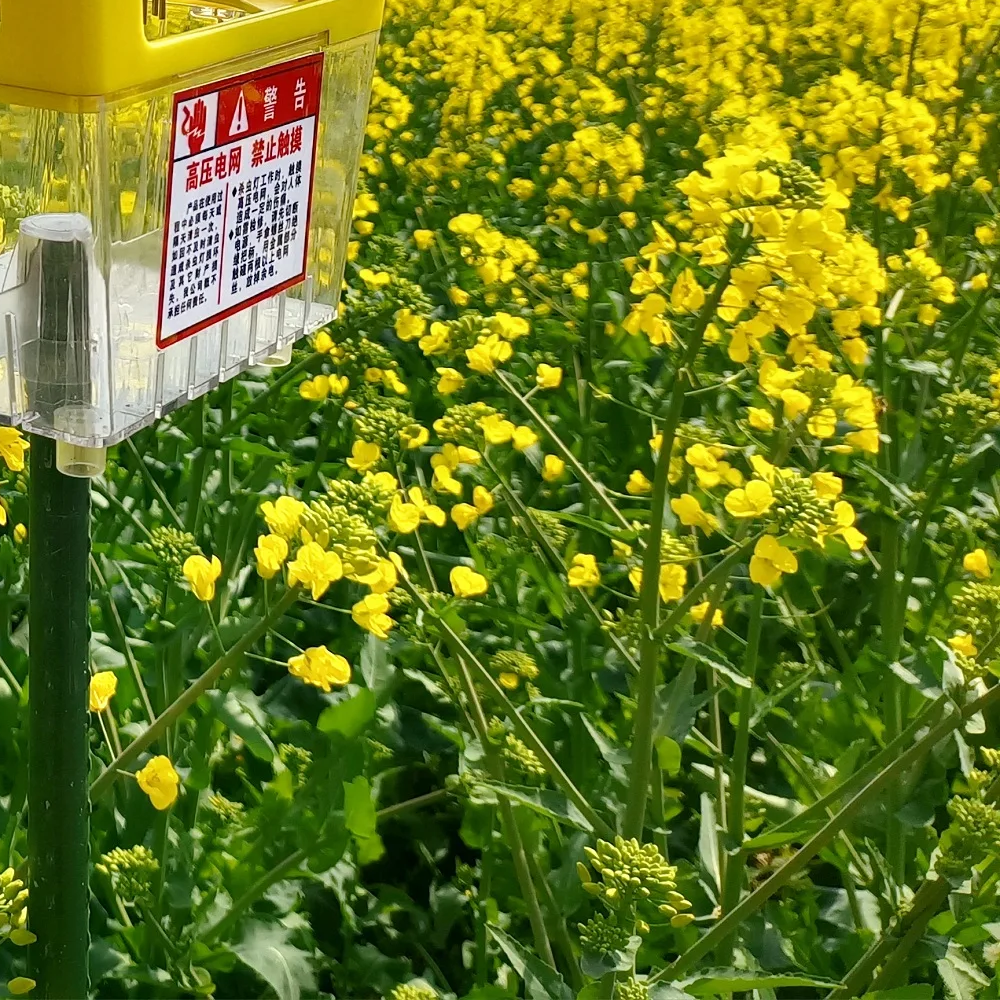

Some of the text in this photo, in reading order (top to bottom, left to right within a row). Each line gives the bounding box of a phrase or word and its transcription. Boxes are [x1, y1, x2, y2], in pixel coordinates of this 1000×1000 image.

[263, 77, 307, 122] 警告
[186, 125, 303, 193] 高压电网 禁止触摸
[187, 190, 223, 214] 产品在使用过
